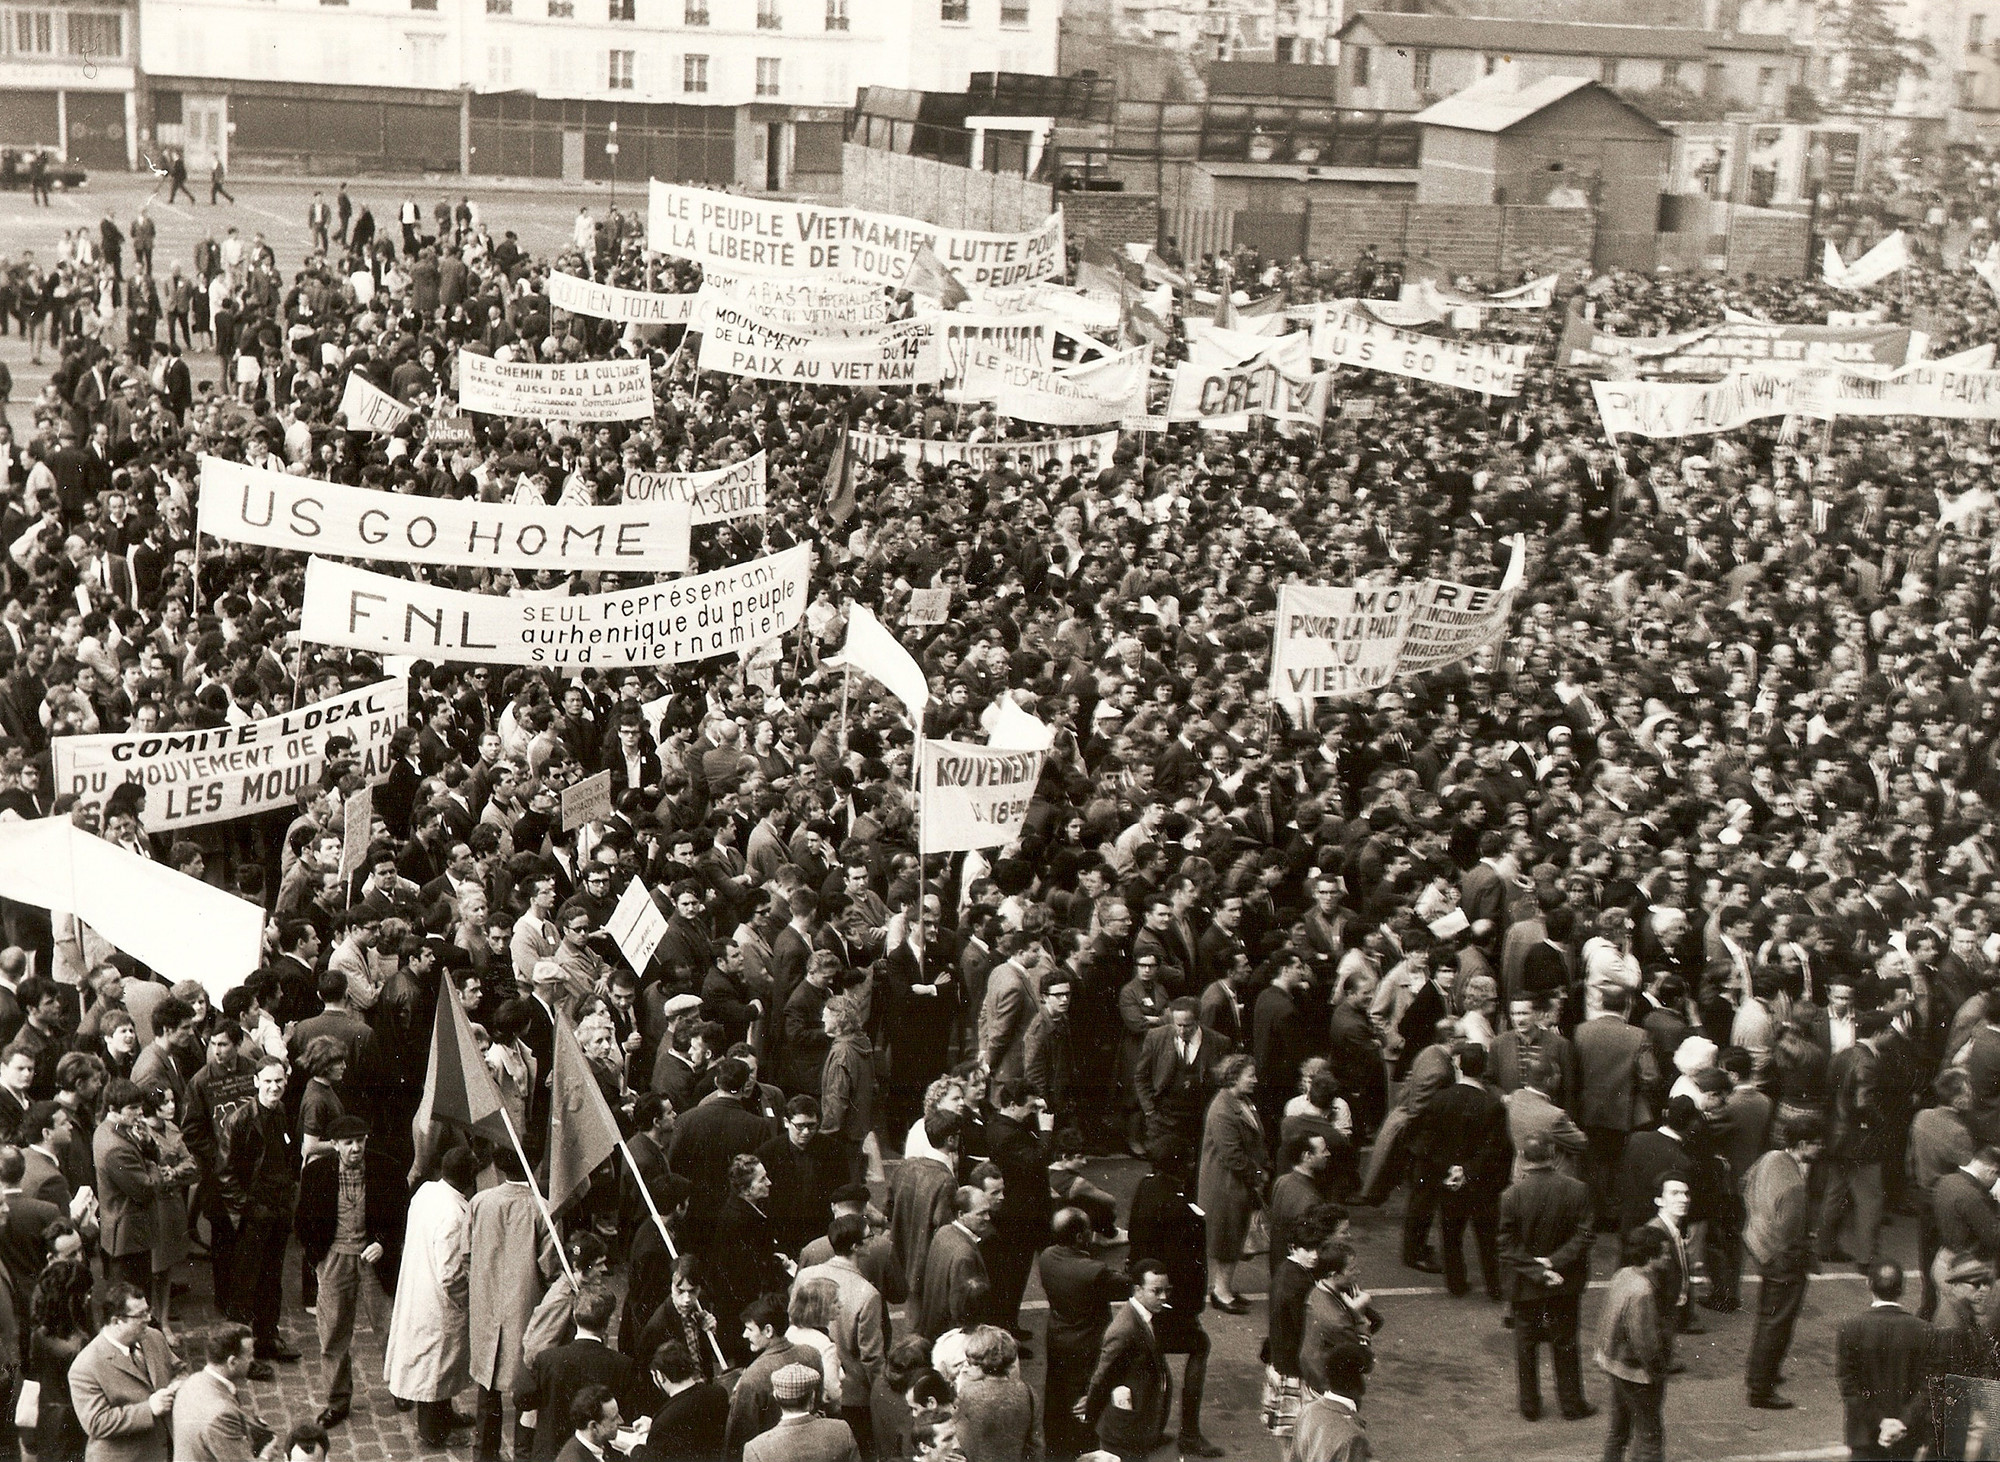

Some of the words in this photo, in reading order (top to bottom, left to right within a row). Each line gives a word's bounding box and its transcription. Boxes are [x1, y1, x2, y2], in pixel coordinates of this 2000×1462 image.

[667, 193, 690, 220] LE
[702, 202, 783, 237] PEUPLE
[949, 237, 1019, 263] LUTTE
[672, 225, 697, 250] LA
[810, 245, 841, 268] DE
[852, 245, 905, 280] TOUS
[553, 279, 612, 313] SOUTIEN
[622, 295, 669, 319] TOTAL
[715, 327, 732, 341] DE
[738, 331, 755, 347] LA
[716, 307, 811, 348] MOUVEMENT
[471, 358, 487, 372] LE
[495, 365, 543, 380] CHEMIN
[551, 369, 566, 381] DE
[575, 369, 590, 380] LA
[596, 364, 640, 379] CULTURE
[732, 352, 784, 375] PAIX
[793, 361, 820, 378] AU
[1402, 350, 1436, 372] GO
[1455, 361, 1526, 392] HOME
[515, 384, 552, 394] AUSSI
[560, 387, 583, 396] PAR
[592, 383, 613, 397] LA
[619, 377, 646, 394] PAIX
[241, 485, 324, 538] US
[358, 508, 437, 549] GO
[468, 521, 651, 557] HOME
[522, 616, 688, 645] authentique
[698, 602, 724, 628] du
[732, 578, 795, 628] peuple
[523, 605, 592, 622] SEUL
[603, 564, 778, 620] représentant
[282, 696, 385, 736] LOCAL
[73, 773, 106, 795] DU
[126, 745, 274, 786] MOUVEMENT
[288, 736, 317, 760] DE
[371, 713, 405, 741] PAI
[166, 782, 223, 820] LES
